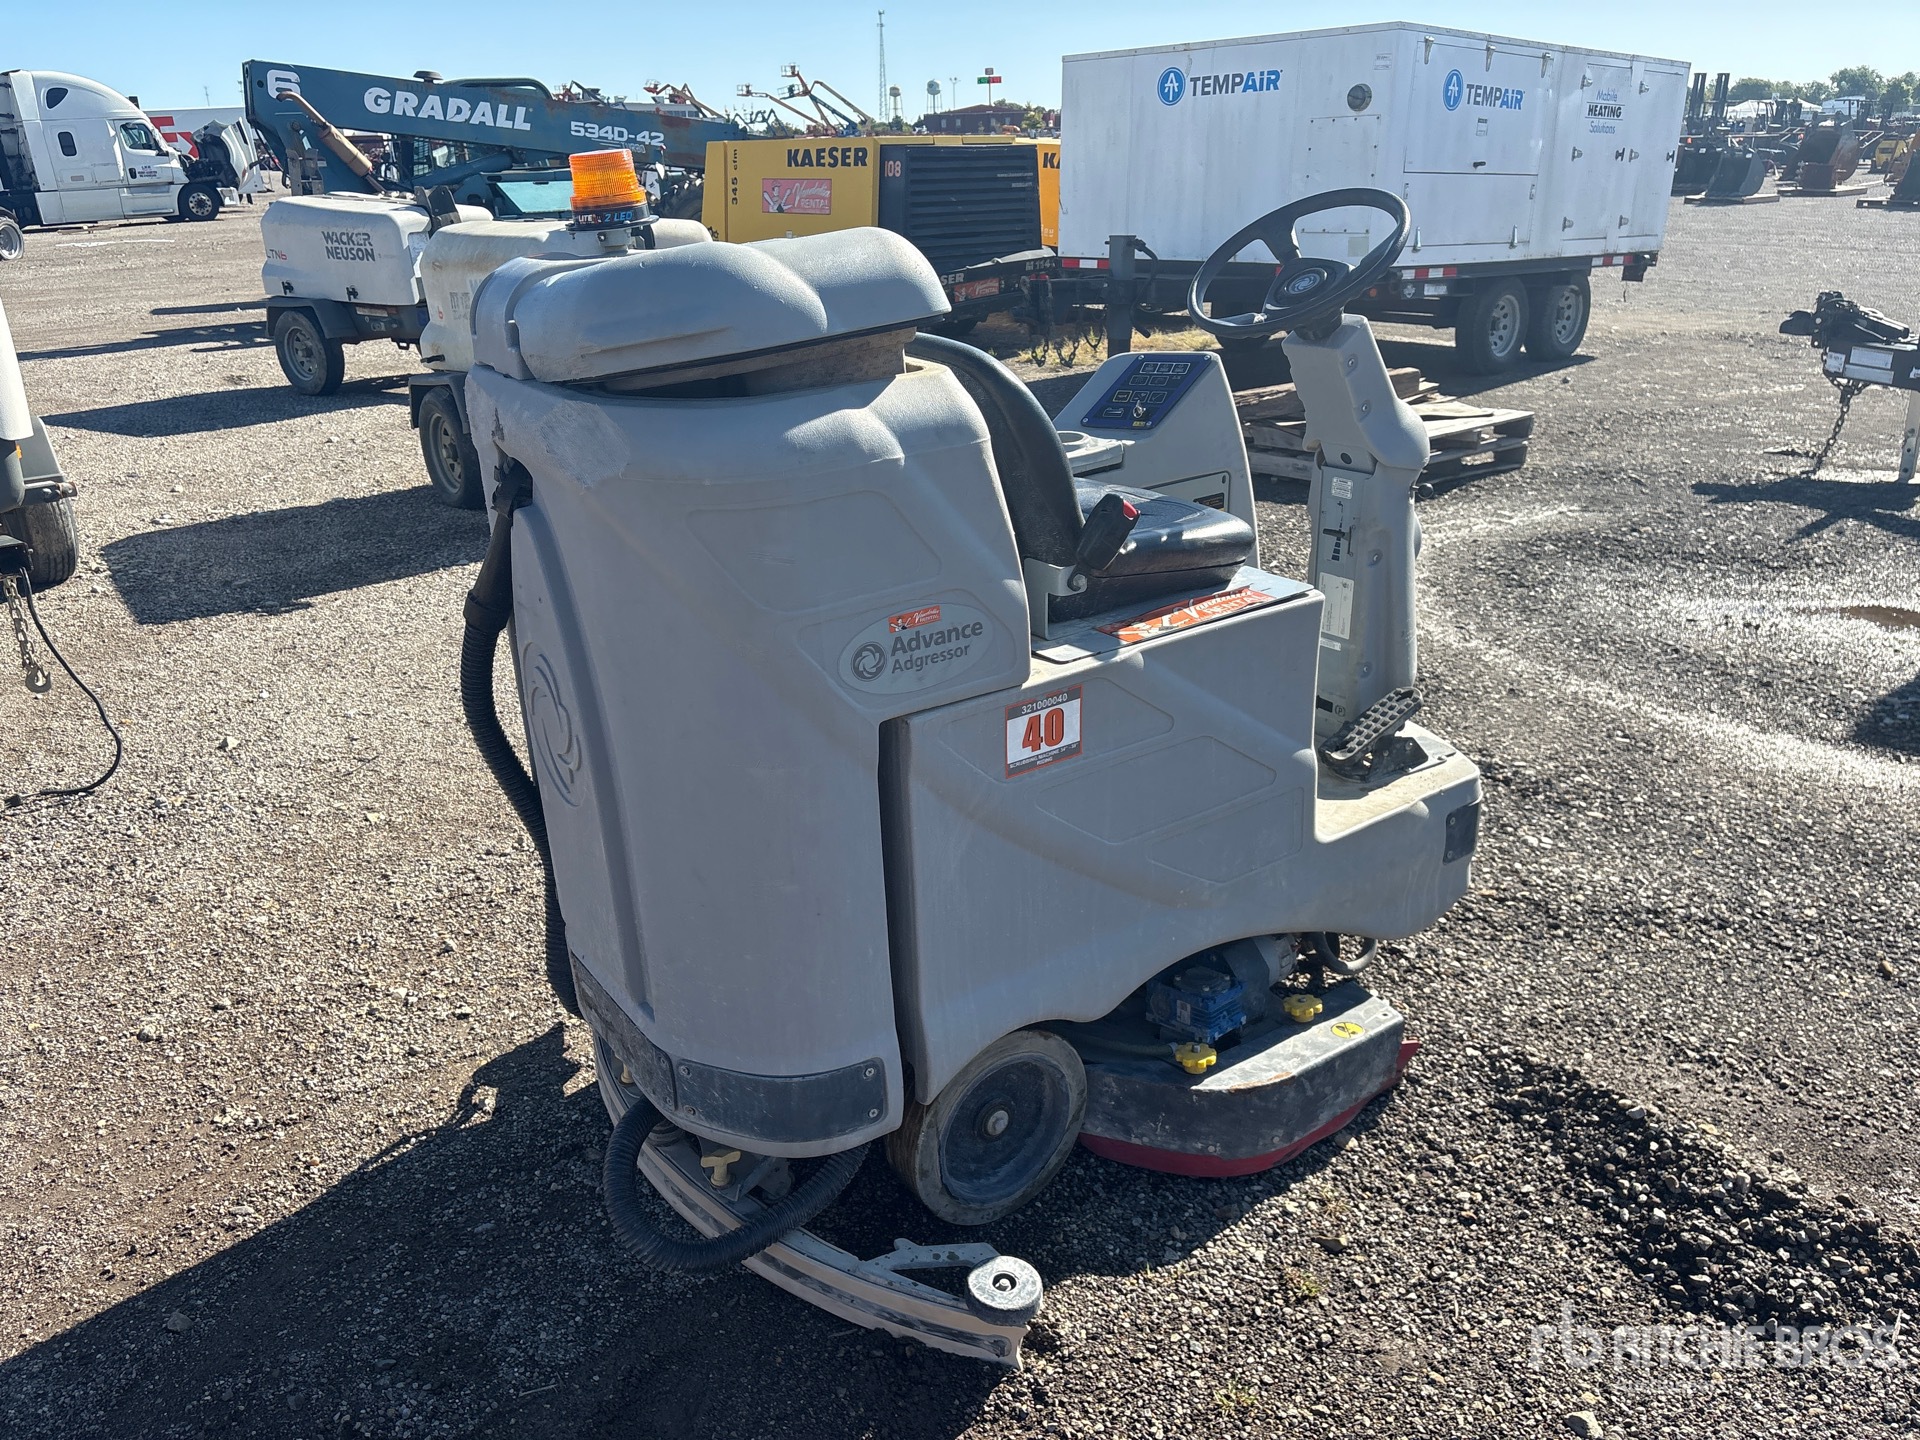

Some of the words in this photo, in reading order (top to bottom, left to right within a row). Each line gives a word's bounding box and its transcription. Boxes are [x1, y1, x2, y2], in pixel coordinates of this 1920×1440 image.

[267, 69, 300, 101] 6
[1596, 88, 1618, 102] Mobile
[364, 87, 531, 131] GRADALL
[1587, 104, 1622, 119] HEATING
[570, 121, 665, 147] 534D-42
[1589, 120, 1616, 134] Solutions
[787, 147, 868, 168] KAESER
[885, 160, 901, 177] 108
[800, 199, 829, 209] RENTAL
[613, 211, 633, 221] LED
[321, 231, 373, 247] WACKER
[325, 246, 376, 262] NEUSON
[890, 621, 984, 657] Advance
[891, 644, 971, 674] Adgressor
[1021, 693, 1068, 714] 321000040
[1022, 708, 1064, 752] 40
[1038, 749, 1060, 759] MACHINE
